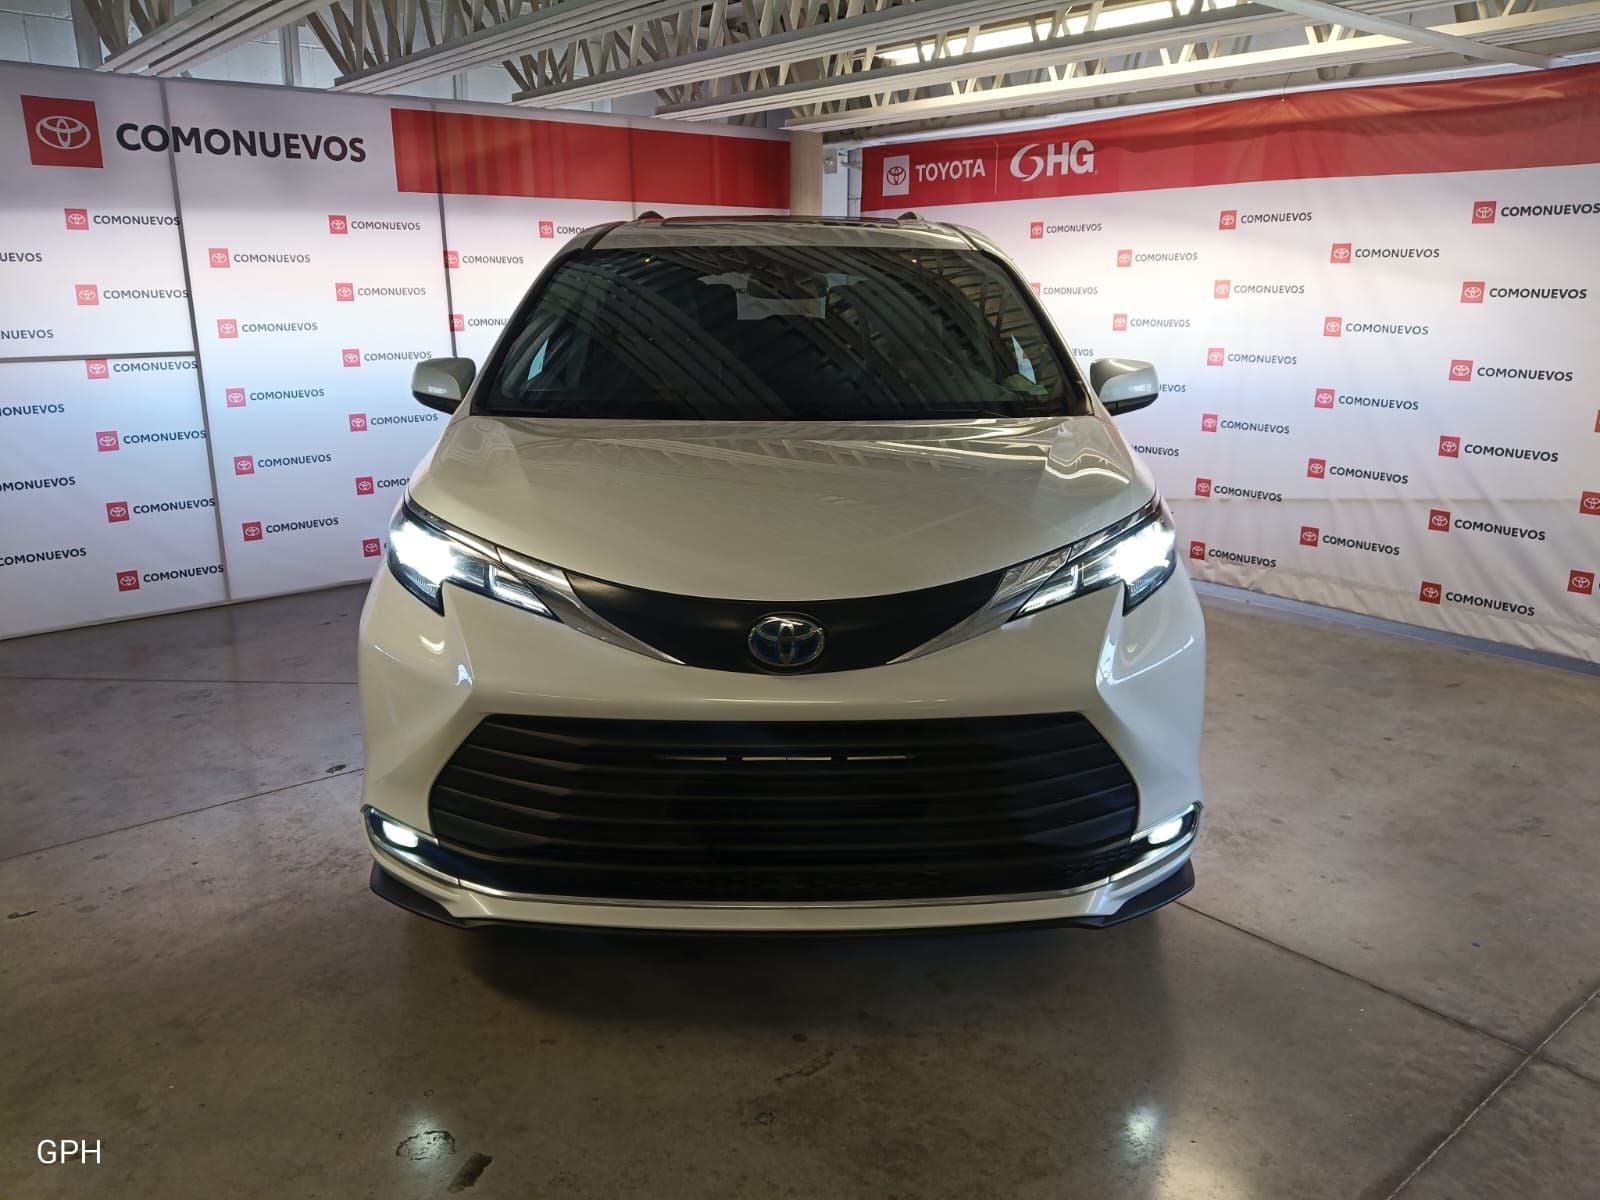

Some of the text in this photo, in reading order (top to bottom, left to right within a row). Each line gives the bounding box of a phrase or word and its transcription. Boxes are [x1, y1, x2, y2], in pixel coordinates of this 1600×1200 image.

[116, 123, 366, 162] COMONUEVOS
[916, 158, 986, 182] TOYOTA
[1501, 203, 1600, 217] COMONUEVOS
[93, 214, 180, 226] COMONUEVOS
[1240, 212, 1312, 224] COMONUEVOS
[351, 219, 421, 231] COMONUEVOS
[557, 226, 585, 235] COMO
[1046, 223, 1102, 233] COMONUEVOS
[233, 253, 311, 264] COMONUEVOS
[1135, 252, 1198, 262] COMONUEVOS
[1355, 248, 1440, 258] COMONUEVOS
[462, 256, 524, 265] COMONUEVOS
[103, 289, 189, 300] COMONUEVOS
[357, 287, 426, 296] COMONUEVOS
[1043, 286, 1098, 295] COMONUEVOS
[1234, 284, 1305, 294] COMONUEVOS
[1489, 288, 1587, 299] COMONUEVOS
[241, 322, 318, 333] COMONUEVOS
[468, 318, 510, 326] COMONU
[1130, 318, 1190, 328] COMONUEVOS
[1345, 323, 1429, 335] COMONUEVOS
[364, 351, 432, 361] COMONUEVOS
[1227, 353, 1297, 365] COMONUEVOS
[112, 360, 198, 373] COMONUEVOS
[1477, 367, 1573, 382] COMONUEVOS
[1159, 384, 1186, 392] EVOS
[250, 388, 325, 401] COMONUEVOS
[1338, 395, 1419, 410] COMONUEVOS
[370, 414, 438, 426] COMONUEVOS
[1220, 420, 1290, 434] COMONUEVOS
[123, 430, 207, 444] COMONUEVOS
[1464, 444, 1559, 462] COMONUEVOS
[257, 454, 332, 468] COMONUEVOS
[1329, 466, 1408, 484] COMONUEVOS
[1214, 485, 1282, 502] COMONUEVOS
[133, 498, 216, 514] COMONUEVOS
[265, 517, 339, 534] COMONUEVOS
[1454, 519, 1546, 541] COMONUEVOS
[1322, 535, 1400, 556] COMONUEVOS
[1208, 549, 1276, 568] COMONUEVOS
[143, 564, 225, 583] COMONUEVOS
[1445, 592, 1535, 616] COMONUEVOS
